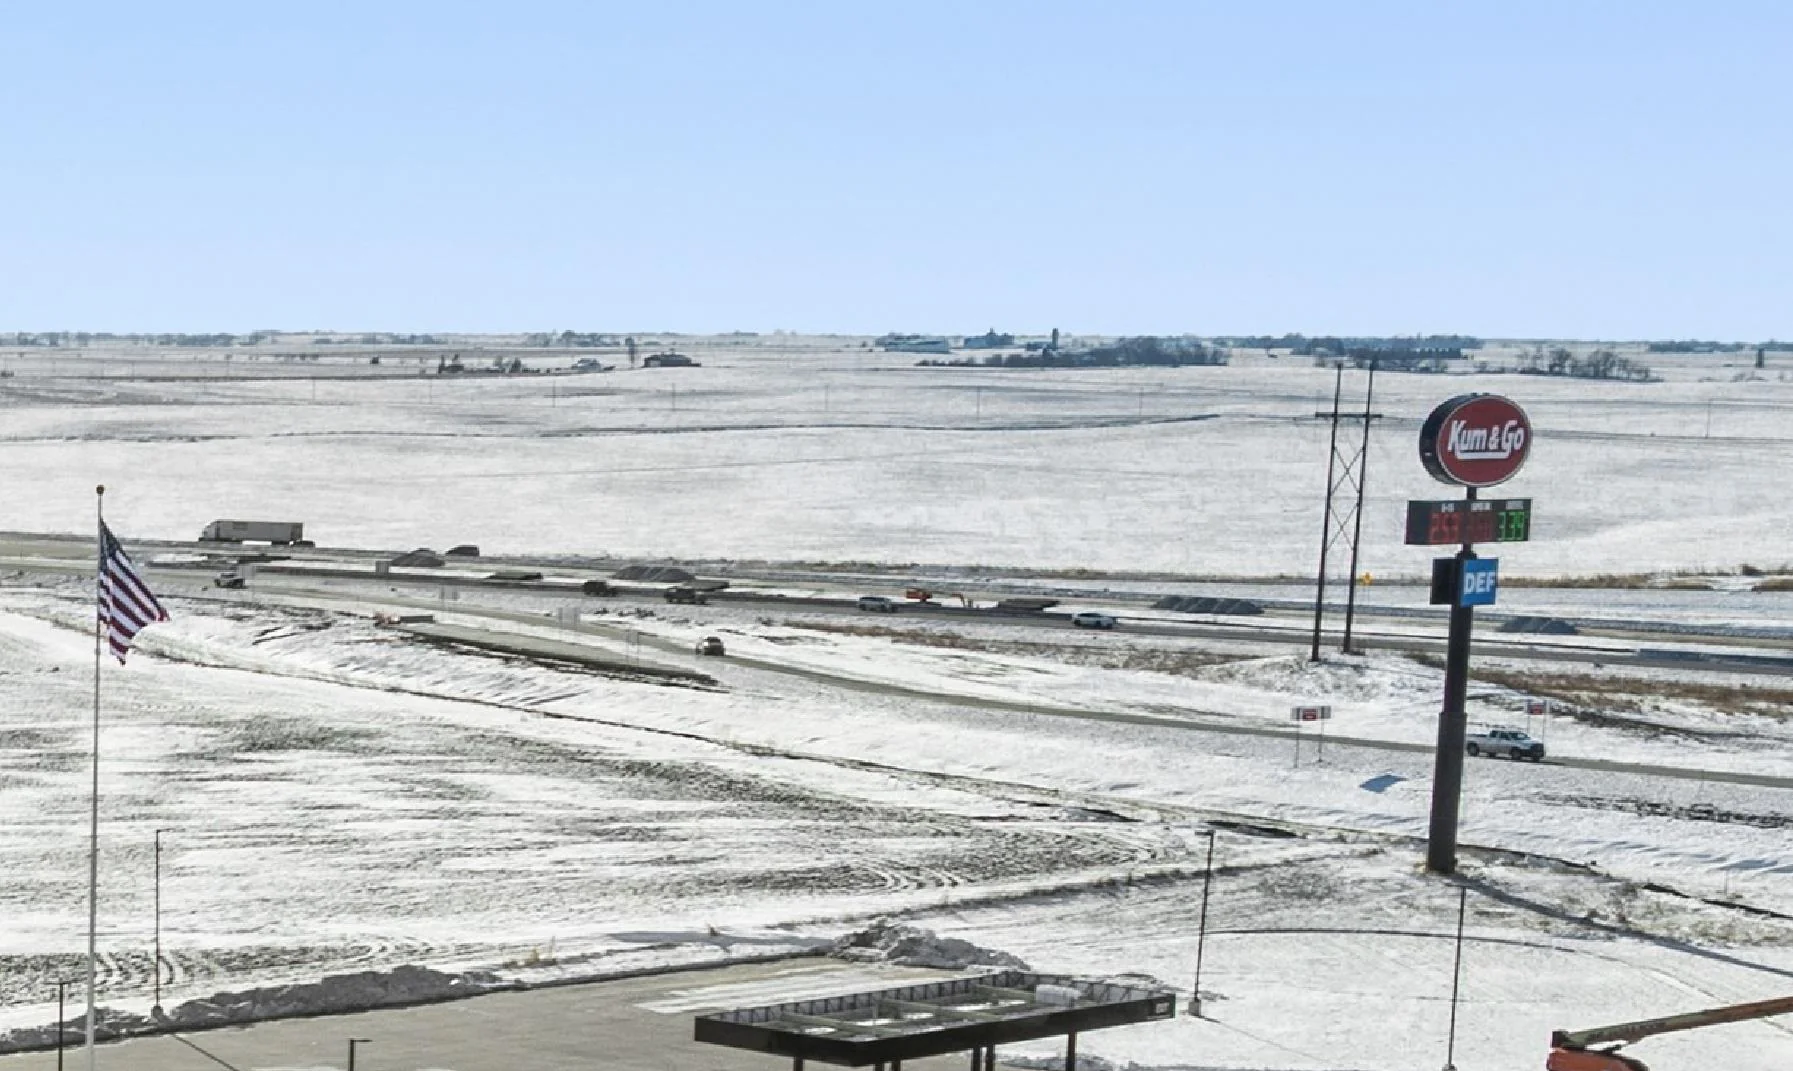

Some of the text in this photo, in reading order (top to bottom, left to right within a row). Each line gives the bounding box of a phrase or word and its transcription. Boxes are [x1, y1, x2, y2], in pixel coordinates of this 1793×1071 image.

[1448, 420, 1524, 457] Kum & Go
[1463, 571, 1496, 594] DEF
